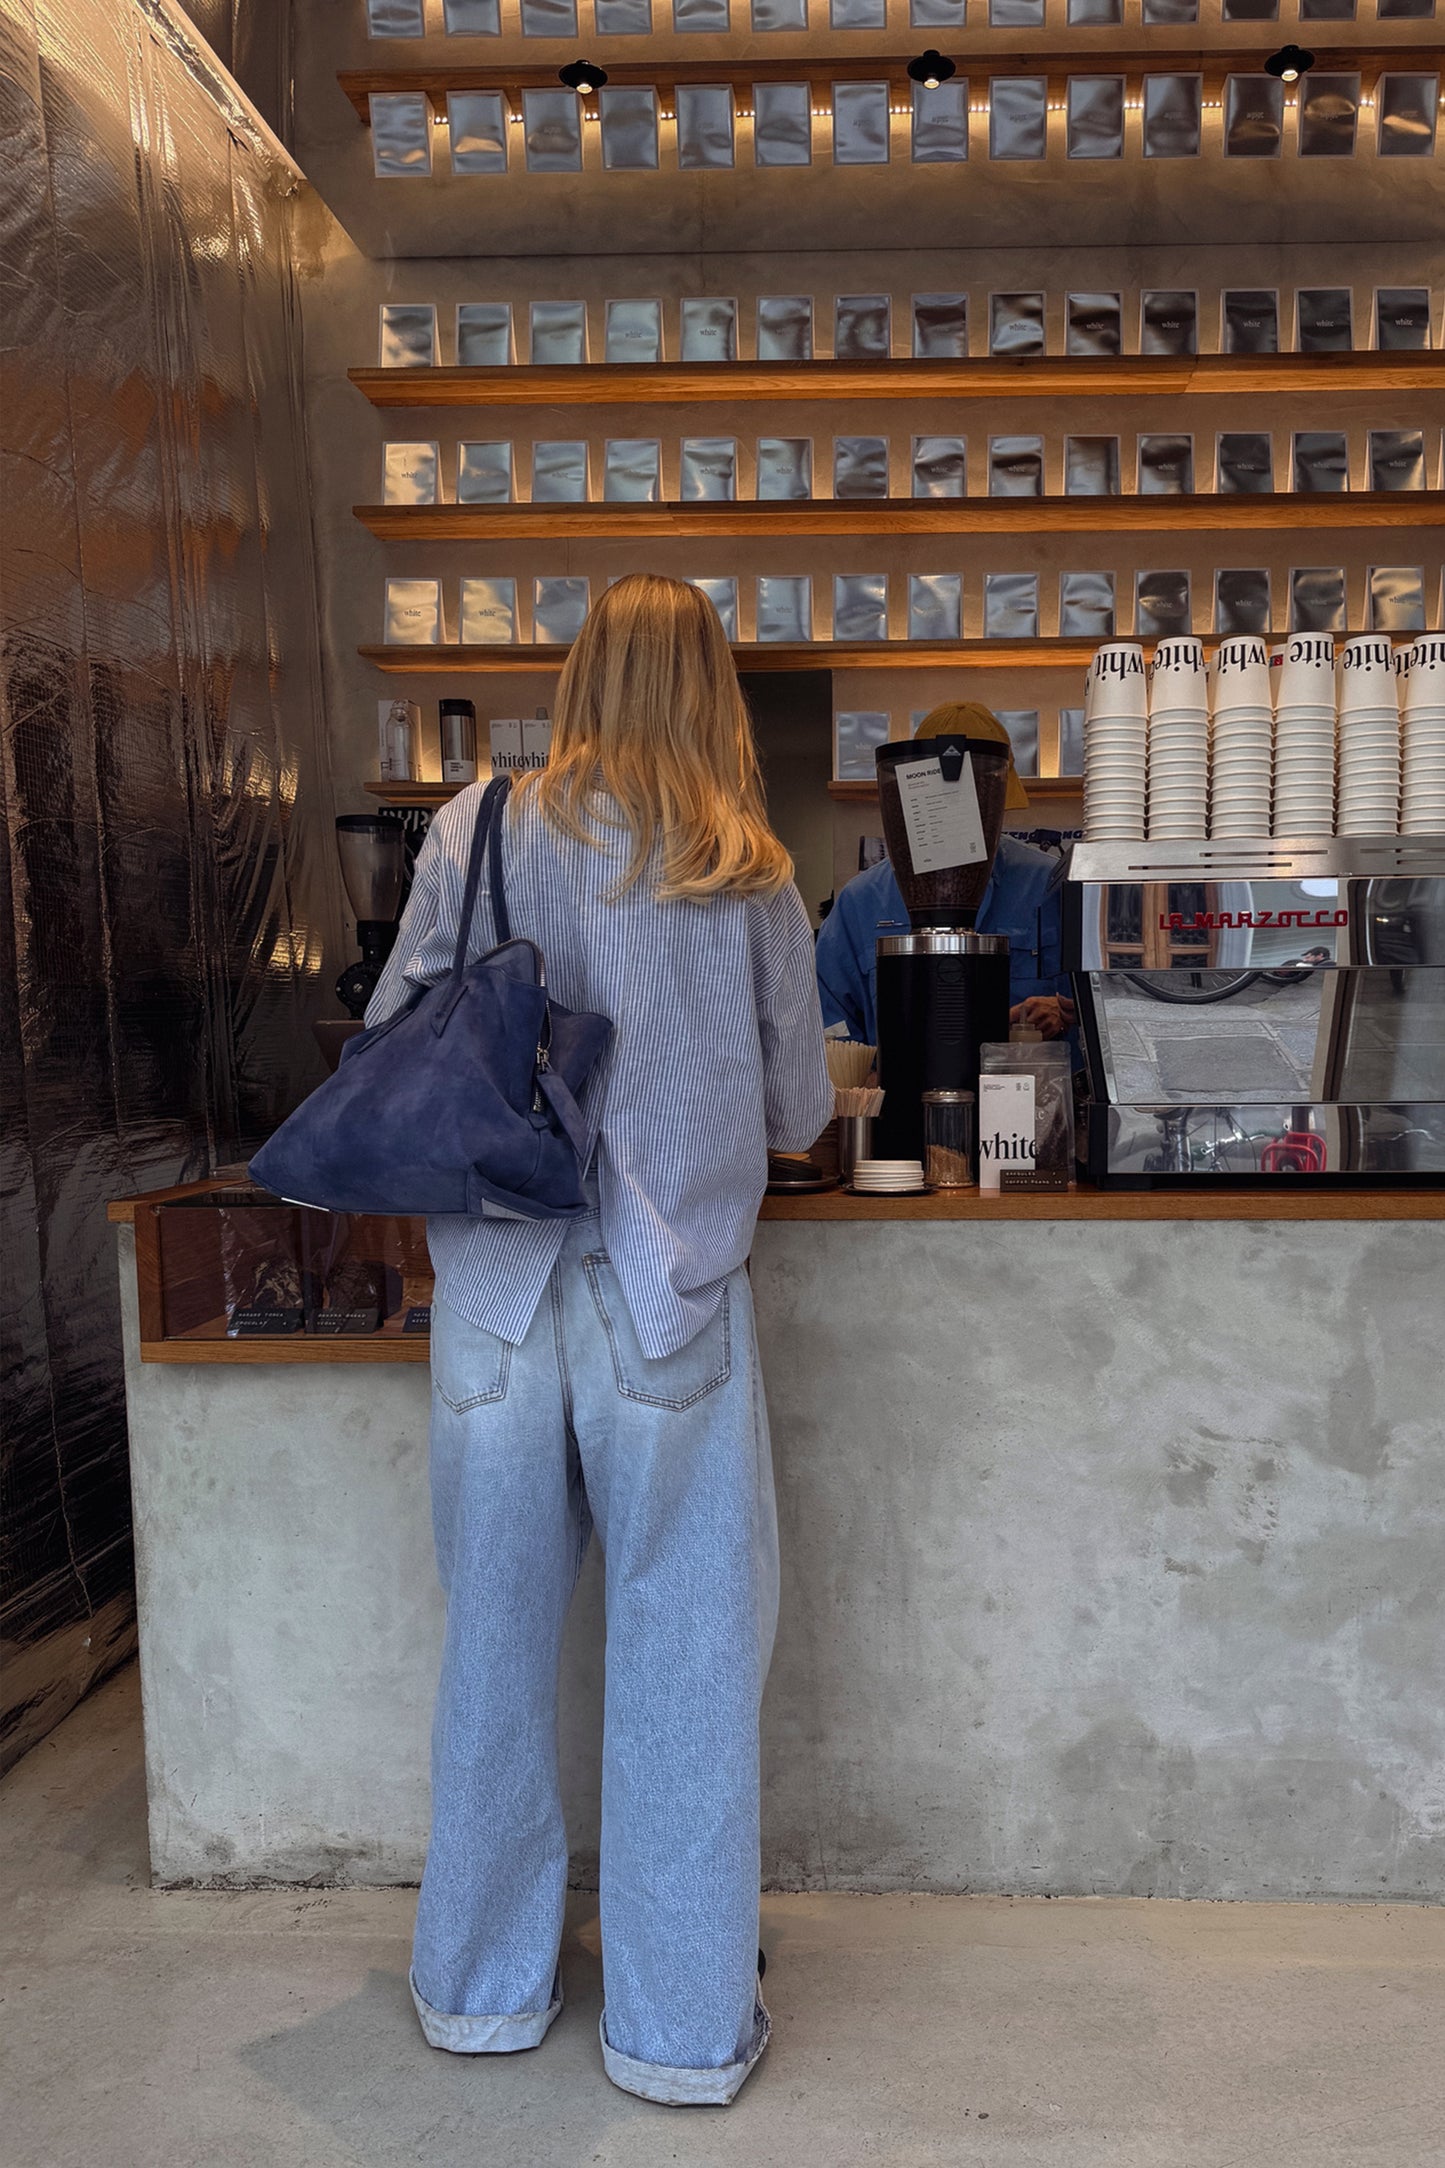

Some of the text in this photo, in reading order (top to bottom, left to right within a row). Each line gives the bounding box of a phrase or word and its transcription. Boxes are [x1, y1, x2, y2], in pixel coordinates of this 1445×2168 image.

[1243, 320, 1261, 328] white
[1316, 319, 1334, 327] white
[1395, 318, 1413, 326] white
[1009, 323, 1026, 331] white
[1235, 599, 1253, 607] white
[404, 609, 421, 617] white
[479, 609, 496, 617] white
[1290, 640, 1334, 671] hite
[1343, 644, 1395, 672] hite
[906, 771, 926, 779] MOON
[1159, 912, 1184, 930] LA
